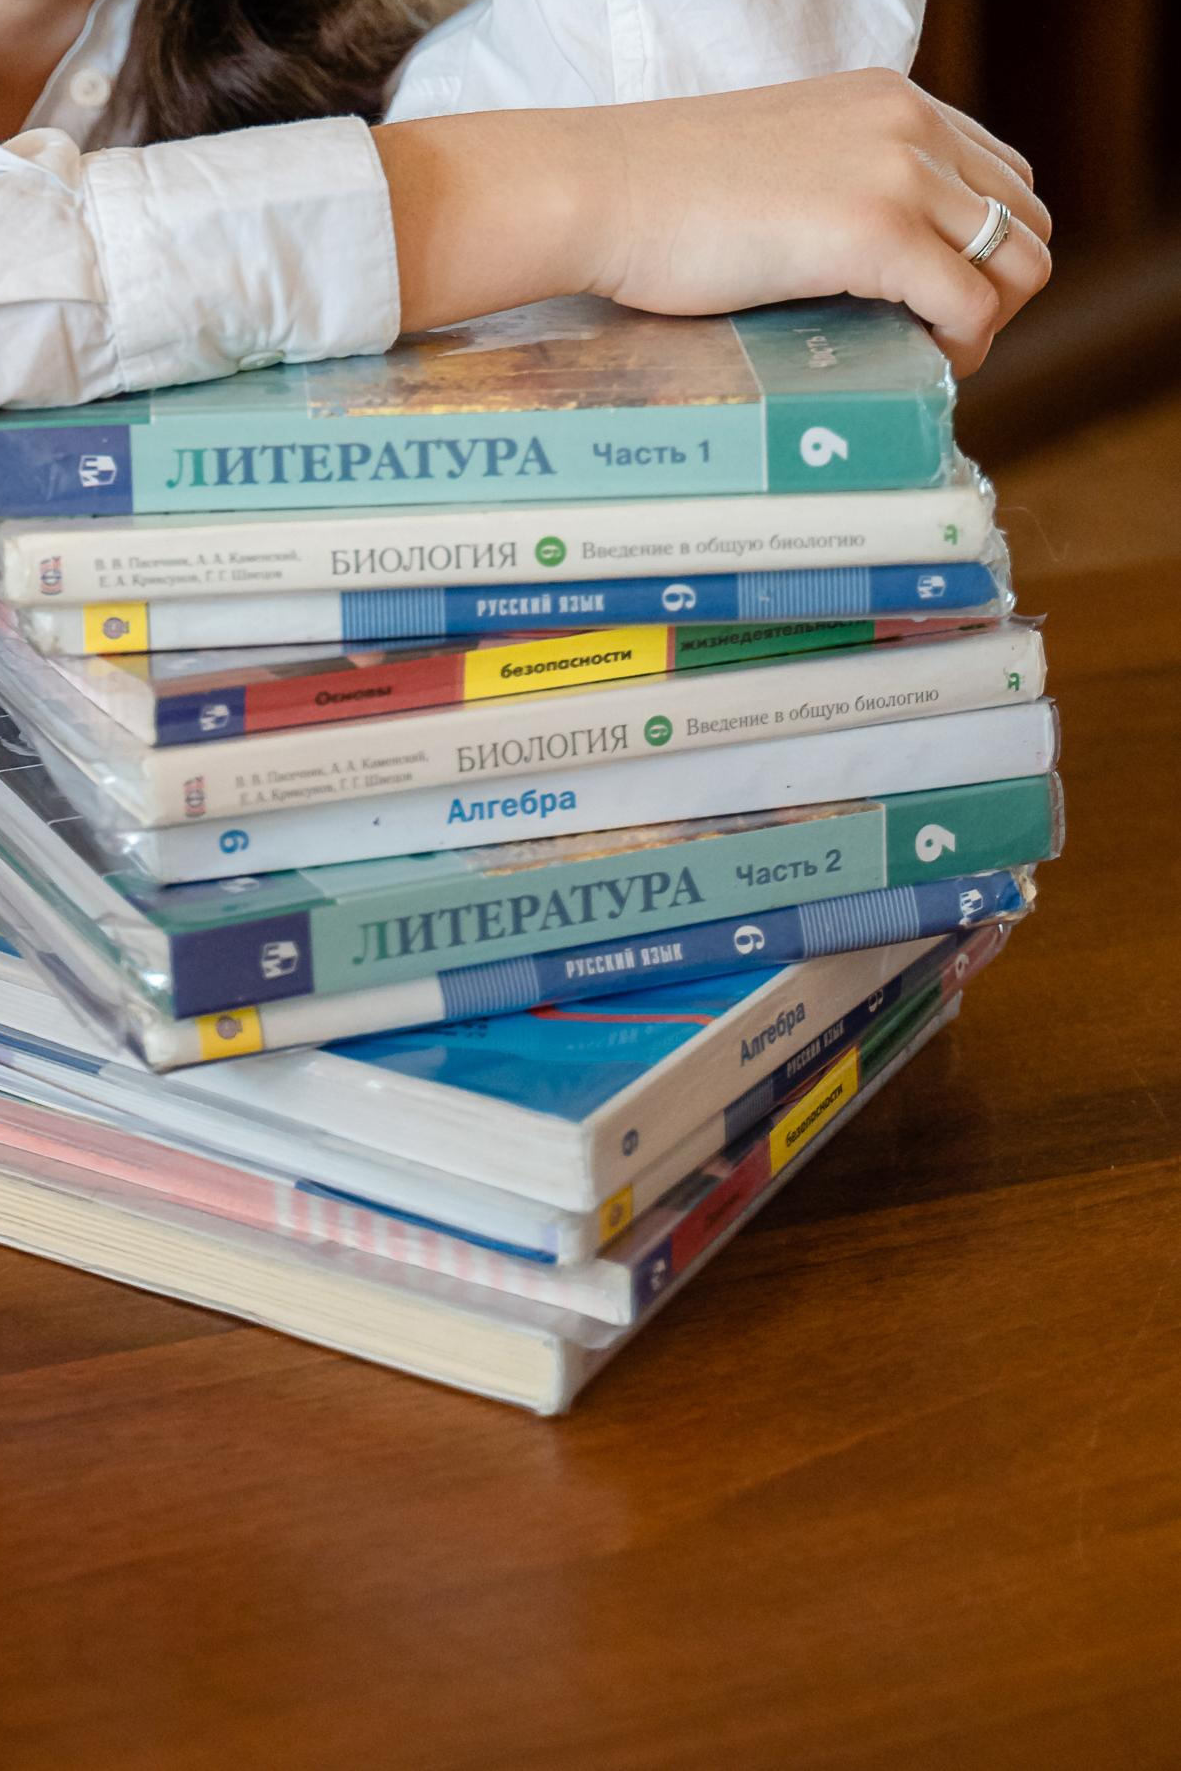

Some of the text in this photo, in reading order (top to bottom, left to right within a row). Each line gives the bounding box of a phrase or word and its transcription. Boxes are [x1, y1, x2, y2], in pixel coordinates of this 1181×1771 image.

[165, 435, 712, 489] ЛИТЕРАТУРА Часть 1
[800, 427, 848, 468] 9
[331, 541, 518, 575] БИОЛОГИЯ
[581, 532, 866, 560] Введение в общую биологию
[477, 593, 605, 617] РУССКИЙ ЯЗЫК
[662, 584, 696, 612] 9
[500, 648, 632, 679] безопасности
[686, 688, 939, 736] Введение в общую биологию
[458, 724, 628, 773] БИОЛОГИЯ
[447, 789, 577, 825] Алгебра
[219, 829, 249, 854] 9
[915, 824, 955, 863] 9
[352, 849, 843, 965] ЛИТЕРАТУРА Часть 2
[733, 925, 765, 955] 9
[565, 943, 683, 979] РУССКИЙ ЯЗЫК
[740, 1003, 806, 1066] Алгебра
[785, 1083, 844, 1147] безопасности
